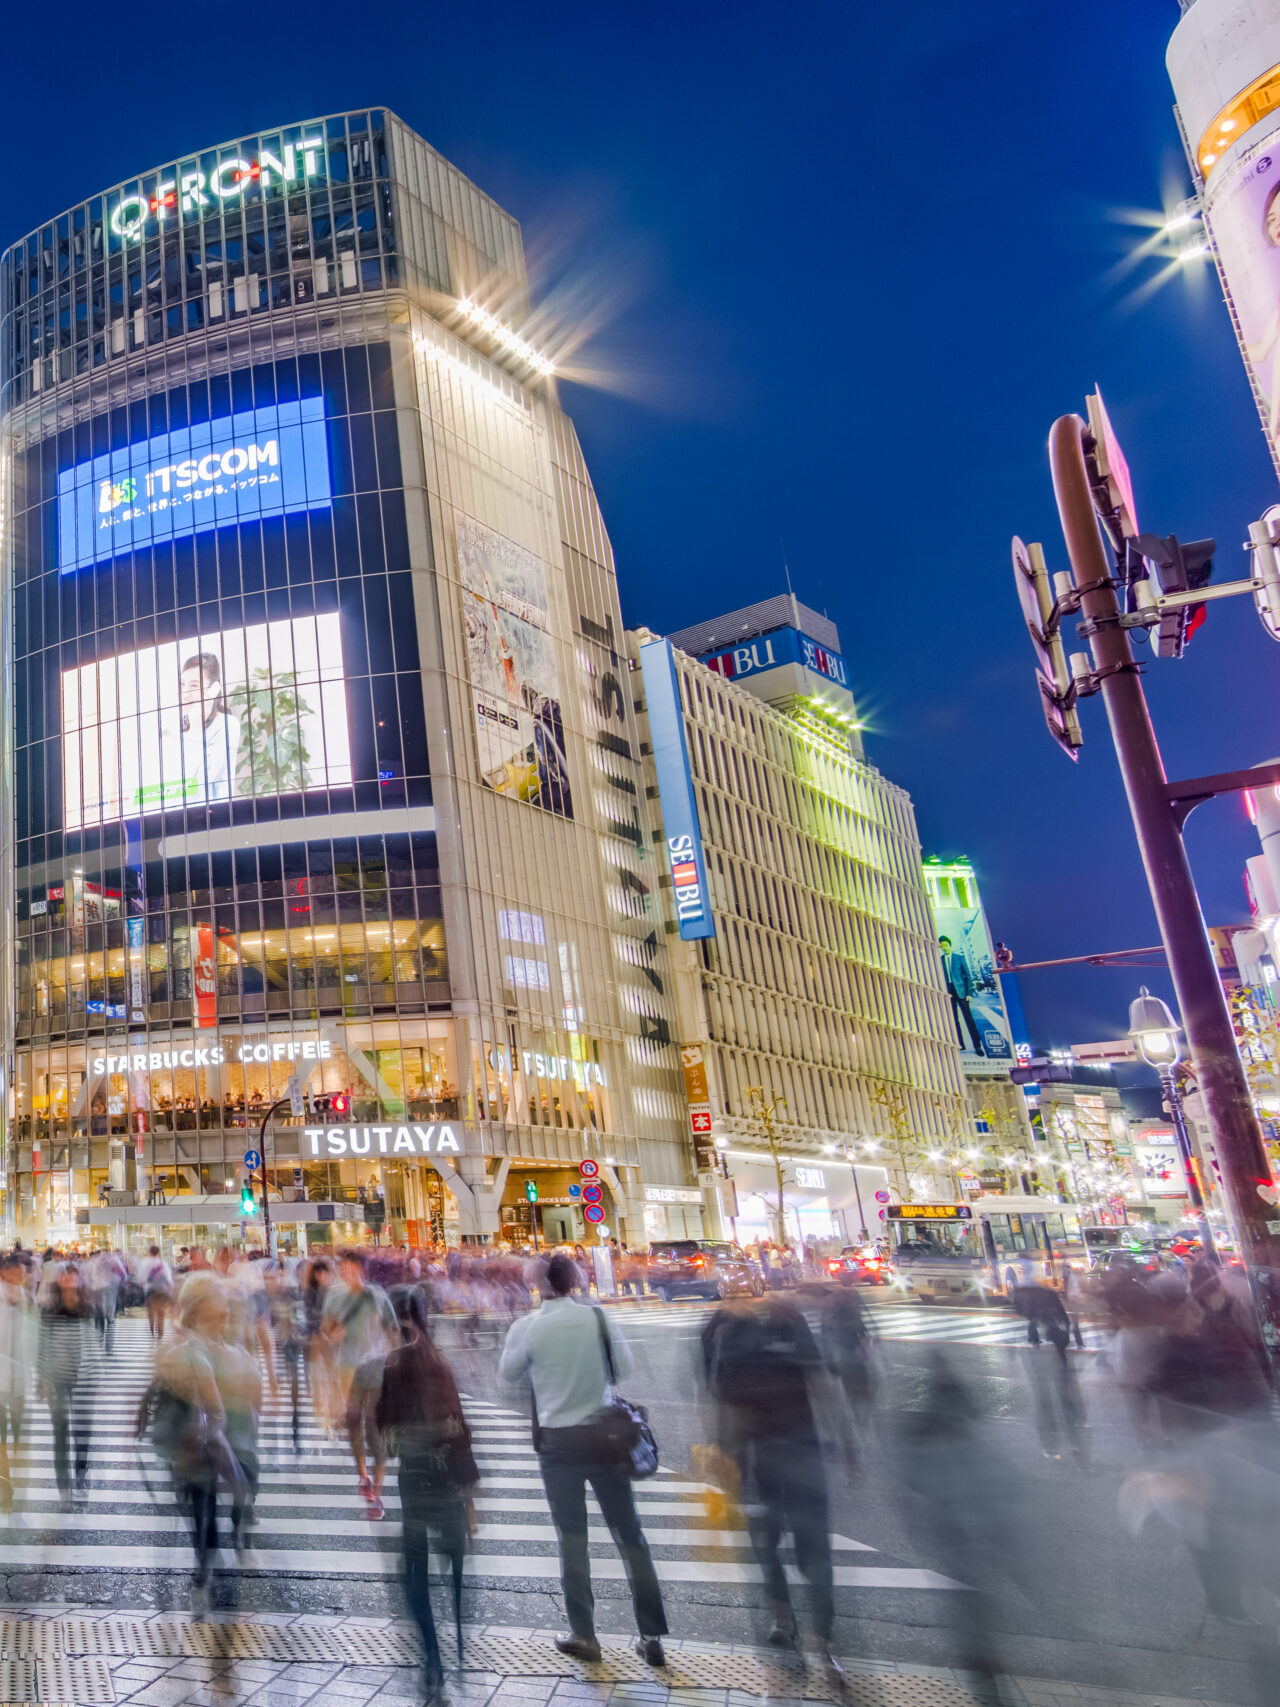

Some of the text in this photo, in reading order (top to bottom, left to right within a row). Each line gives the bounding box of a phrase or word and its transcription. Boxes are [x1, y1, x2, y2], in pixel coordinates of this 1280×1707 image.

[668, 835, 704, 921] SEIBU
[94, 1040, 331, 1075] STARBUCKS COFFEE
[523, 1051, 607, 1087] TSUTAYA
[694, 1114, 709, 1130] 本
[305, 1126, 460, 1154] TSUTAYA
